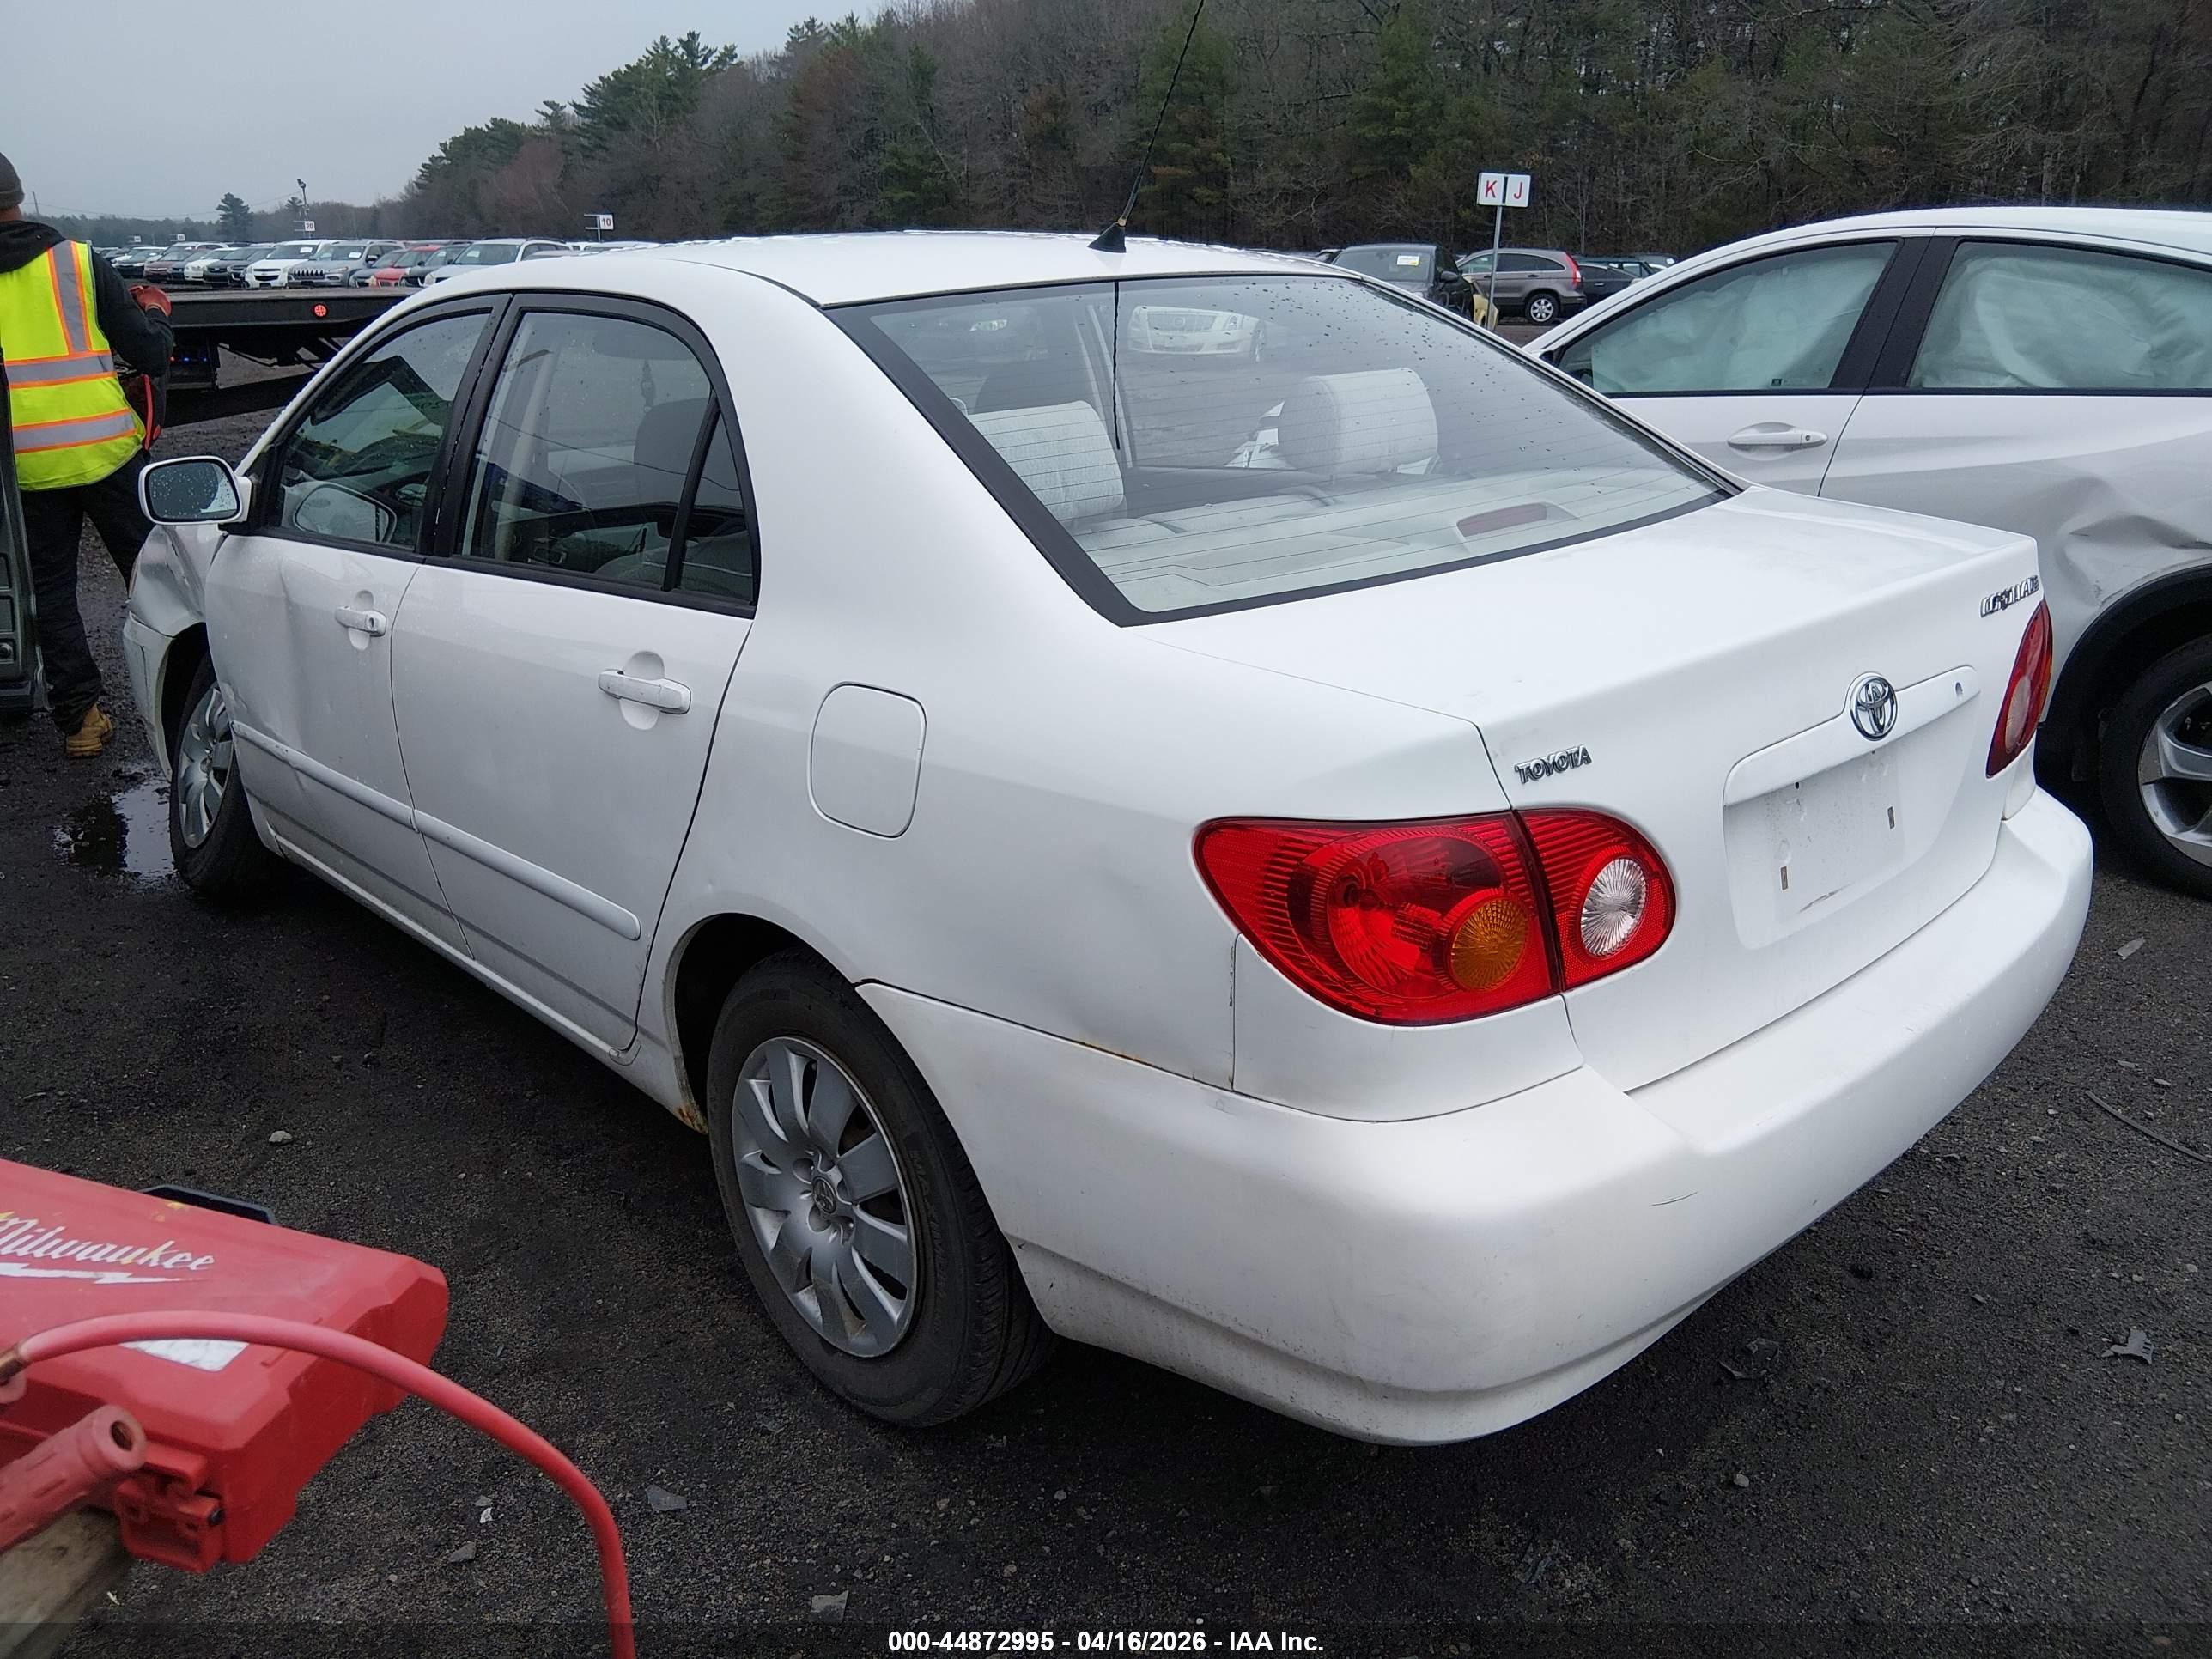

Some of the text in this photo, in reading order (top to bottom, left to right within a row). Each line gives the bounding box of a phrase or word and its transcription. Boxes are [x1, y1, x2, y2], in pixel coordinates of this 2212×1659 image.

[1485, 180, 1522, 199] K J
[1514, 744, 1592, 784] TOYOTA
